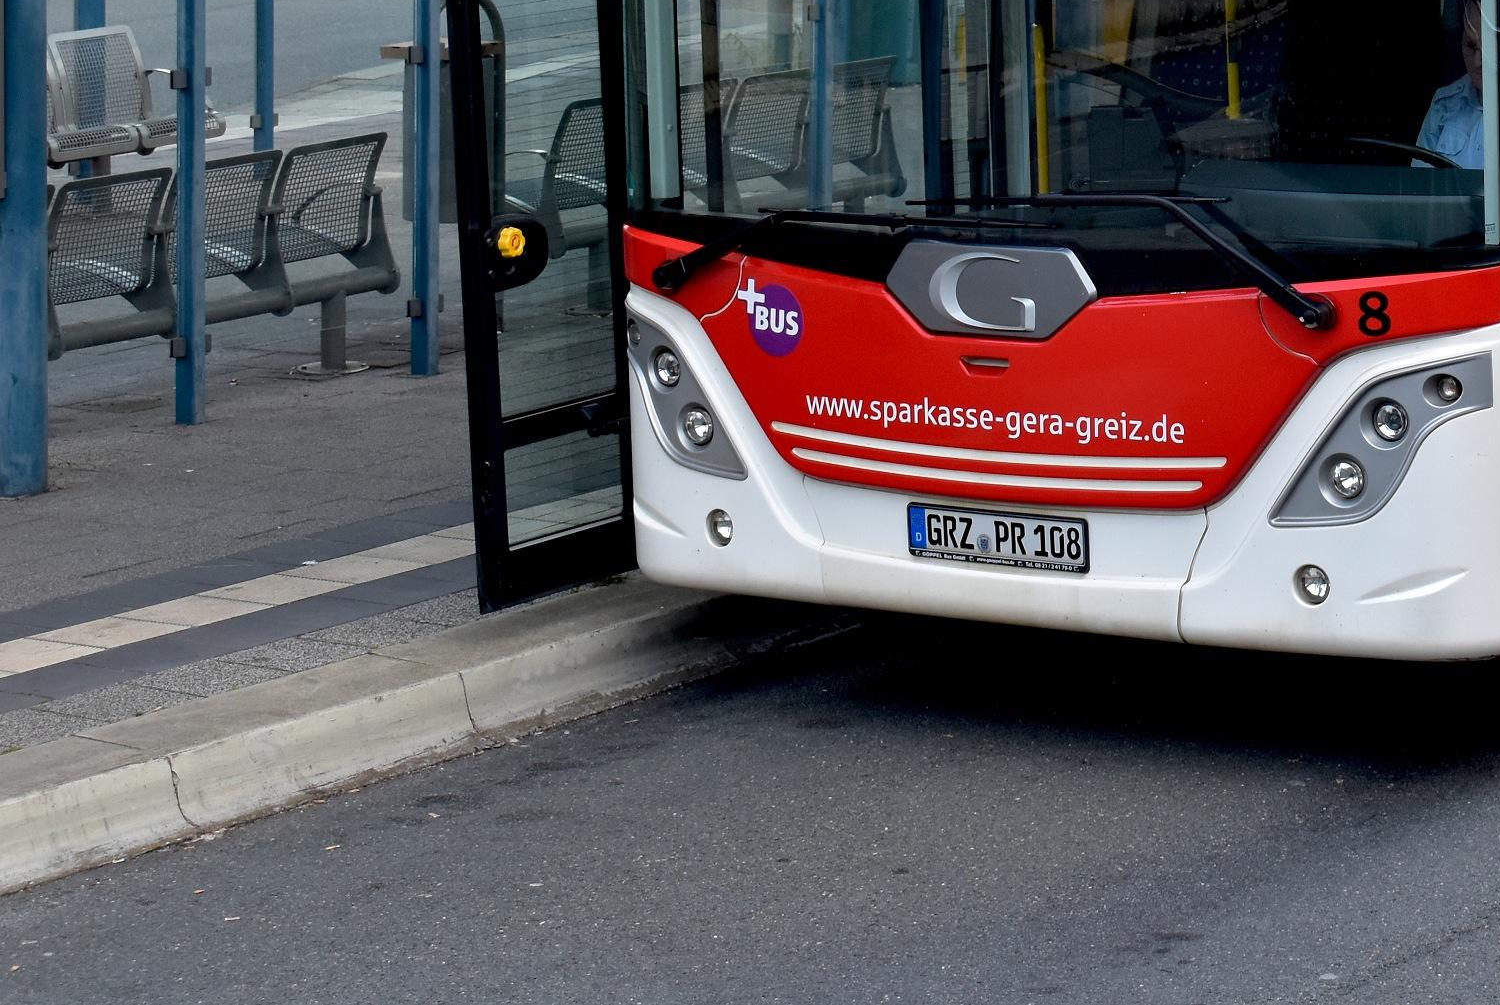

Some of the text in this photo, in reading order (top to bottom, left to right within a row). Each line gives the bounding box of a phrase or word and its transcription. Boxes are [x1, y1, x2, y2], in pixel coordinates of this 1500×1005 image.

[1358, 290, 1392, 337] 8
[805, 394, 1185, 445] www.sparkasse-gera-greiz.de
[927, 513, 1082, 560] GRZ PR 108
